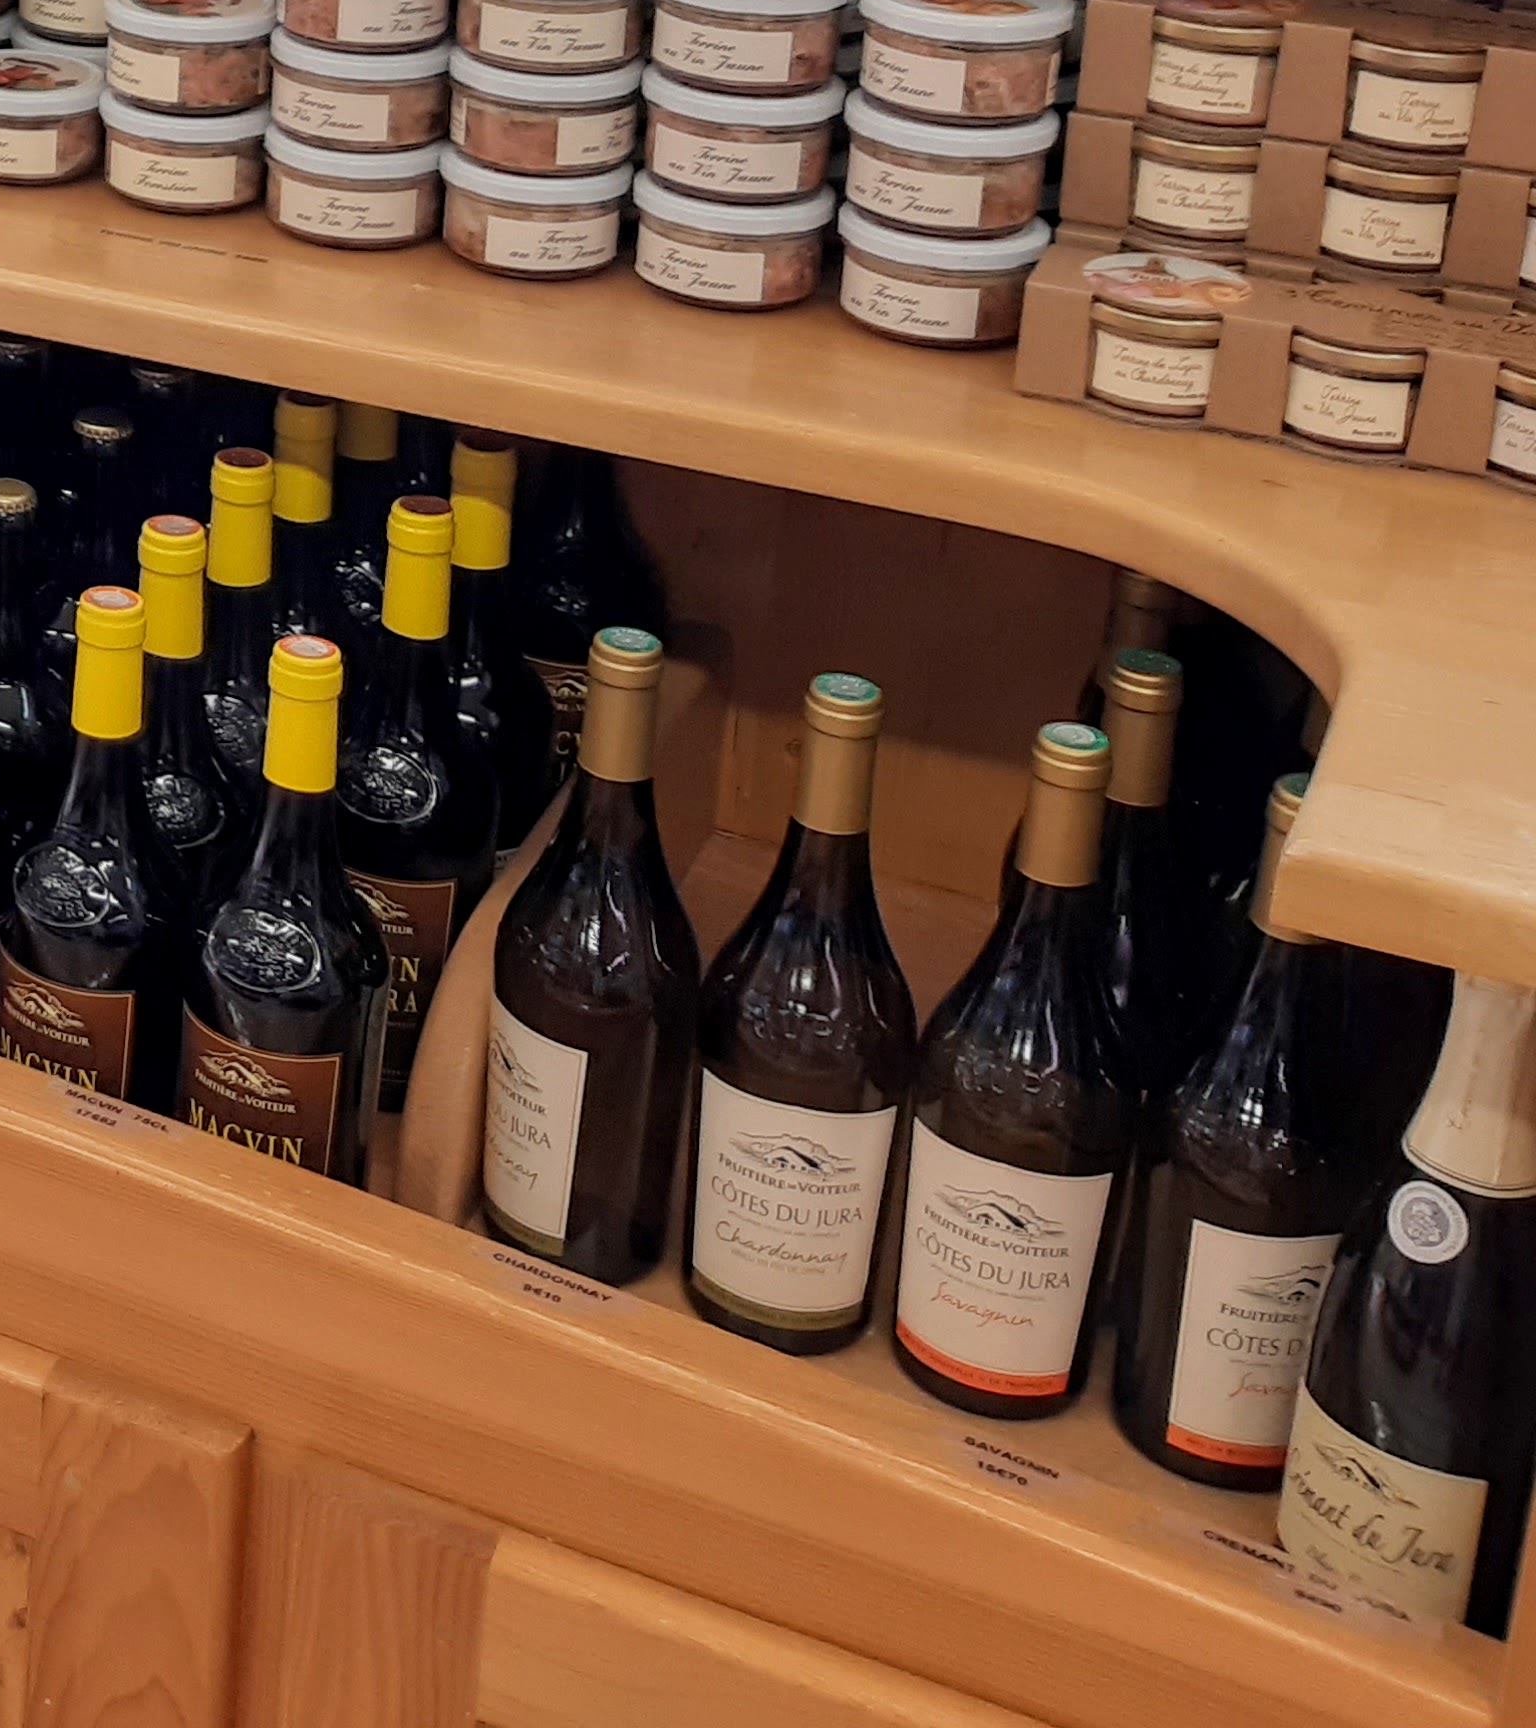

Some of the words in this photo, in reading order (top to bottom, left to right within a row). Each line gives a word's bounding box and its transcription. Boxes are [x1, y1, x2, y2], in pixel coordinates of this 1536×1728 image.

[42, 1026, 90, 1047] VOITEUR
[65, 1087, 123, 1115] MACVIN
[243, 1095, 296, 1114] VOITEUR
[510, 1113, 552, 1150] JURA
[717, 1152, 787, 1192] FRUITIÈRE
[798, 1180, 861, 1195] VOITEUR
[711, 1174, 769, 1218] CÔTES
[776, 1203, 810, 1225] DU
[816, 1206, 863, 1229] JURA
[715, 1220, 848, 1273] Chardonnay
[924, 1205, 989, 1248] FRUITIÈRE
[1002, 1241, 1069, 1257] VOITEUR
[492, 1252, 613, 1303] CHARDONNAY
[916, 1224, 972, 1274] CÔTES
[977, 1261, 1013, 1286] DU
[1019, 1271, 1071, 1291] JURA
[931, 1280, 1034, 1327] Savagnin
[1220, 1303, 1299, 1324] FRUITIÈRE
[1206, 1326, 1280, 1358] CÔTES
[964, 1435, 1060, 1479] SAVAGNIN
[1202, 1529, 1296, 1573] CREMANT
[1394, 1525, 1455, 1574] Jura
